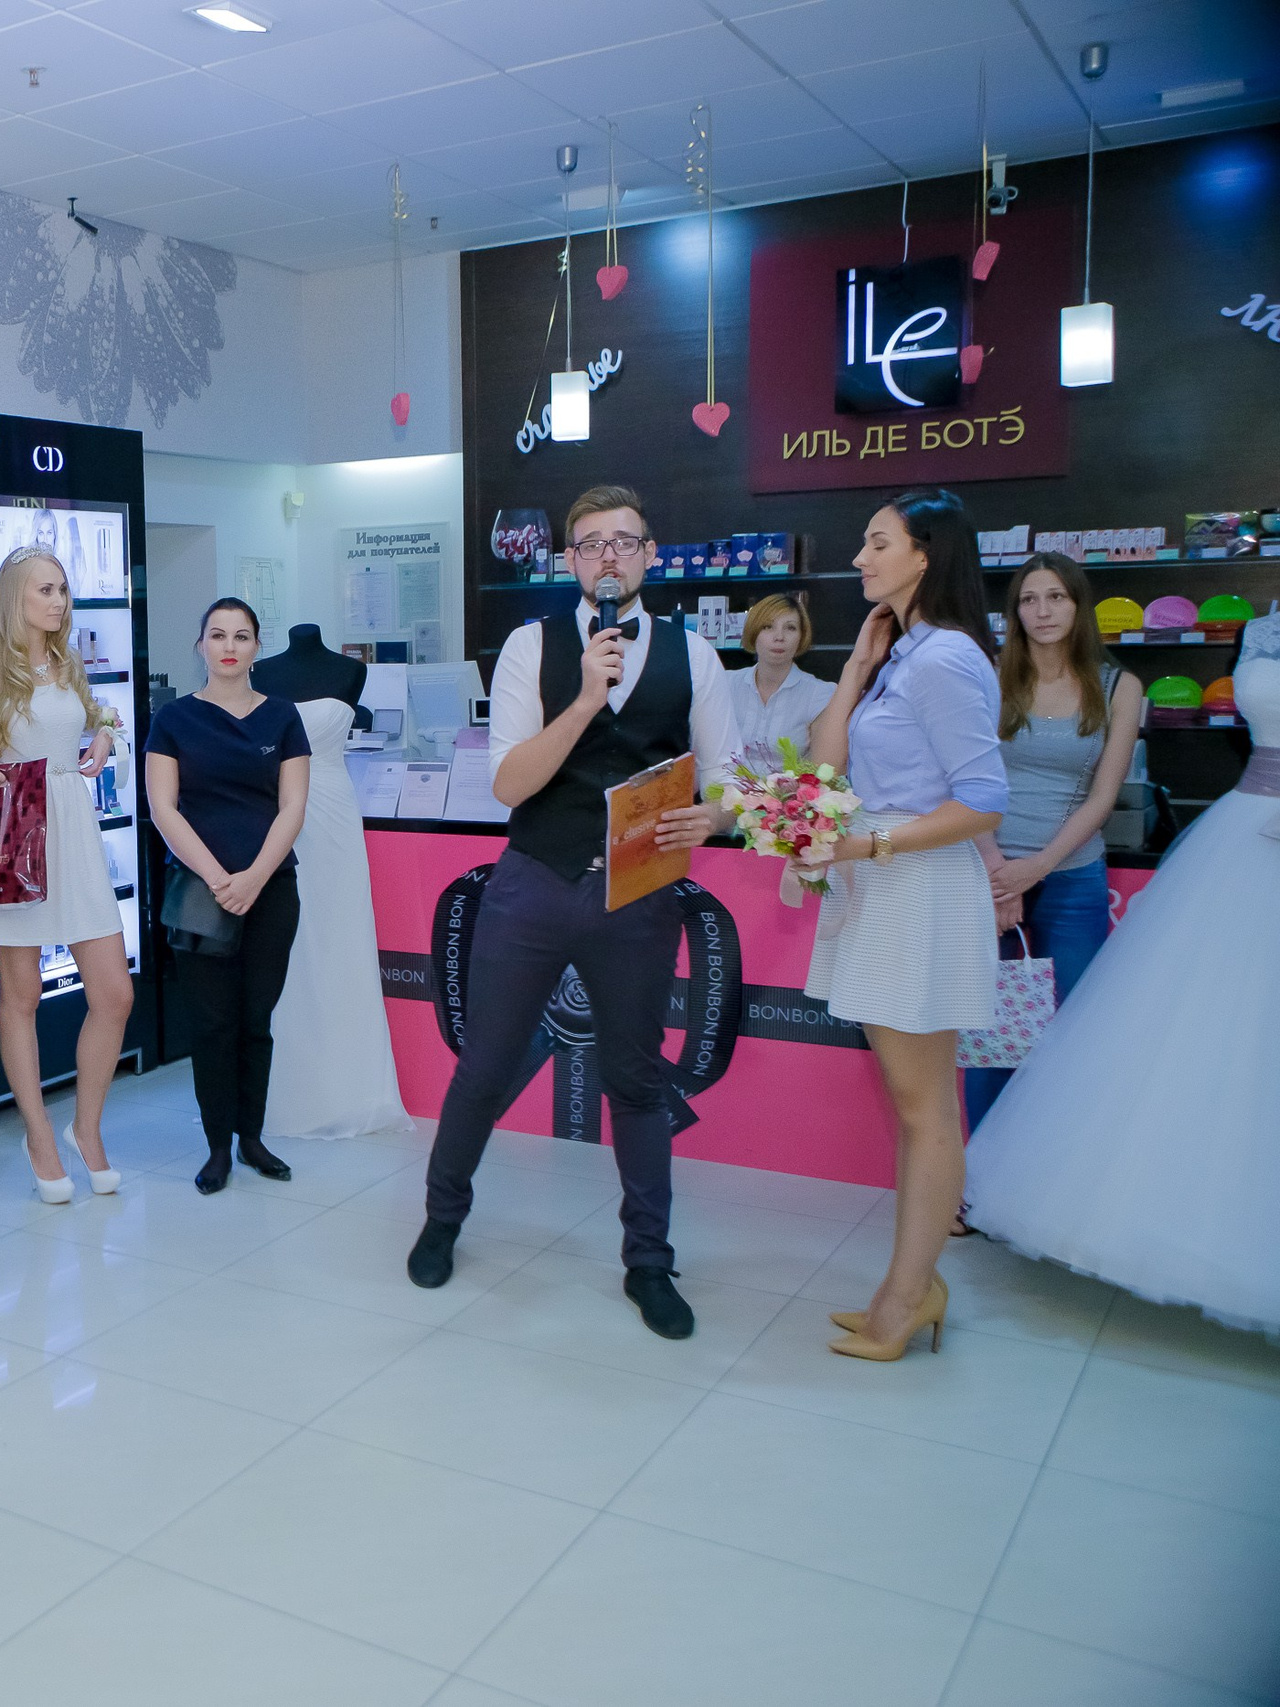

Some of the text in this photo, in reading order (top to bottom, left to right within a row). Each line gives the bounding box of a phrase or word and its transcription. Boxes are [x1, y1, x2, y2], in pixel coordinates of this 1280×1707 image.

[783, 429, 851, 460] ИЛЬ
[860, 424, 908, 460] ДЕ
[32, 445, 64, 472] CD
[347, 542, 440, 559] для покупателей
[355, 532, 431, 546] Информация
[57, 976, 74, 988] Dior
[446, 932, 462, 1007] BONBON
[704, 955, 723, 1036] BONBON
[748, 1003, 834, 1026] BONBON
